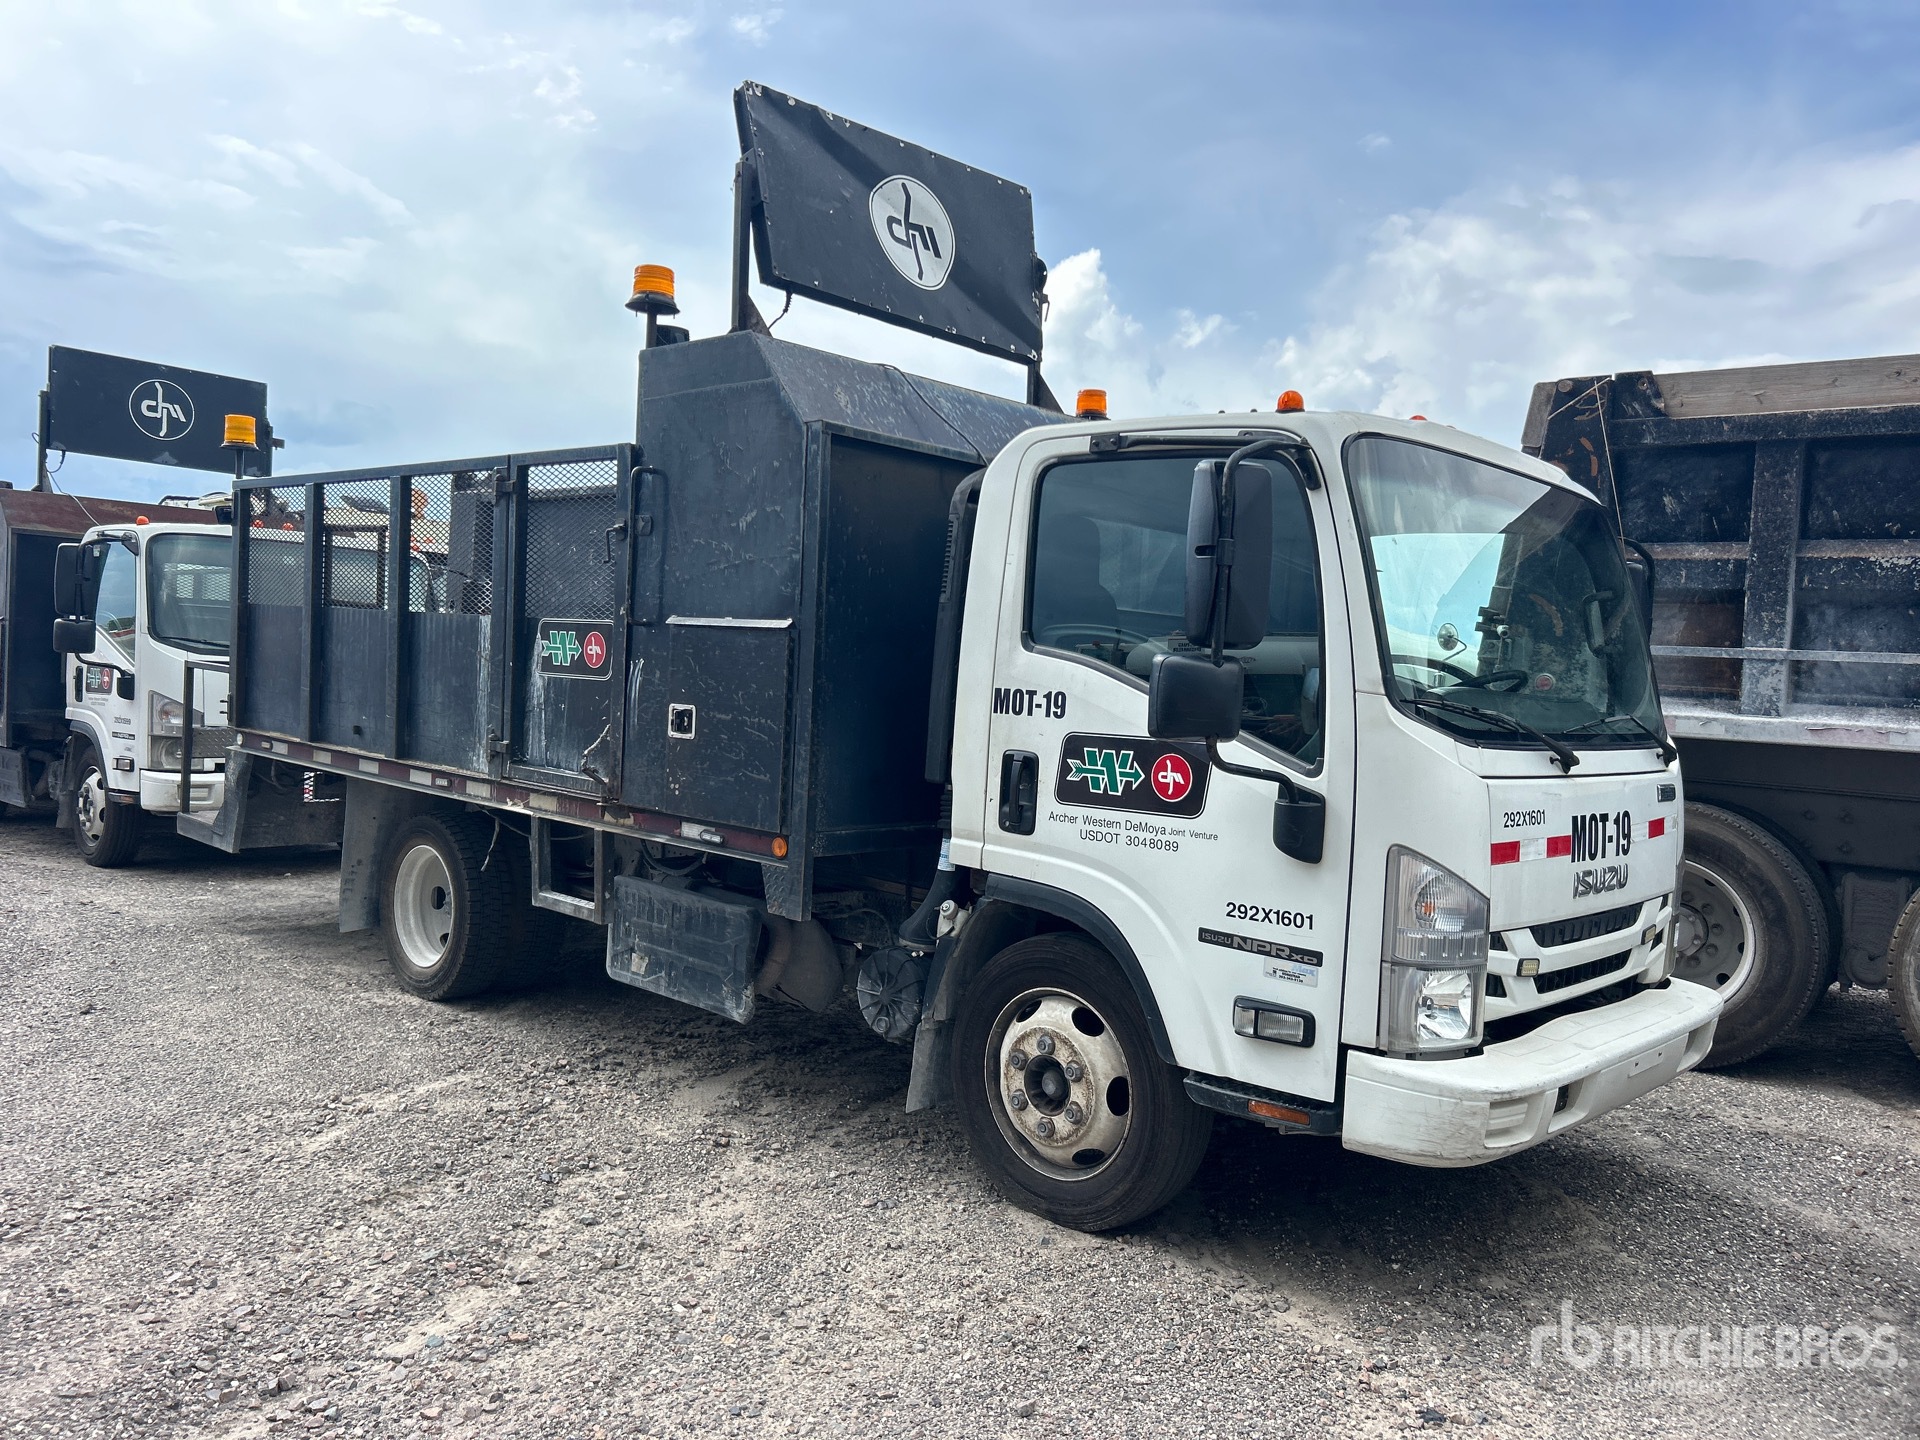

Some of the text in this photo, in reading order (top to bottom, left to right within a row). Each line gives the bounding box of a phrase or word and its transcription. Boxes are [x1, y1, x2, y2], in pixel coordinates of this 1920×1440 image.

[992, 687, 1067, 719] MOT-19
[1048, 811, 1219, 841] Archer Western DeMoya Joint Venture
[1503, 809, 1546, 829] 292X1601
[1079, 828, 1179, 852] USDOT 3048089
[1570, 810, 1632, 864] MOT-19
[1572, 863, 1629, 899] ISUZU
[1225, 901, 1314, 931] 292X1601
[1202, 931, 1231, 945] ISUZU
